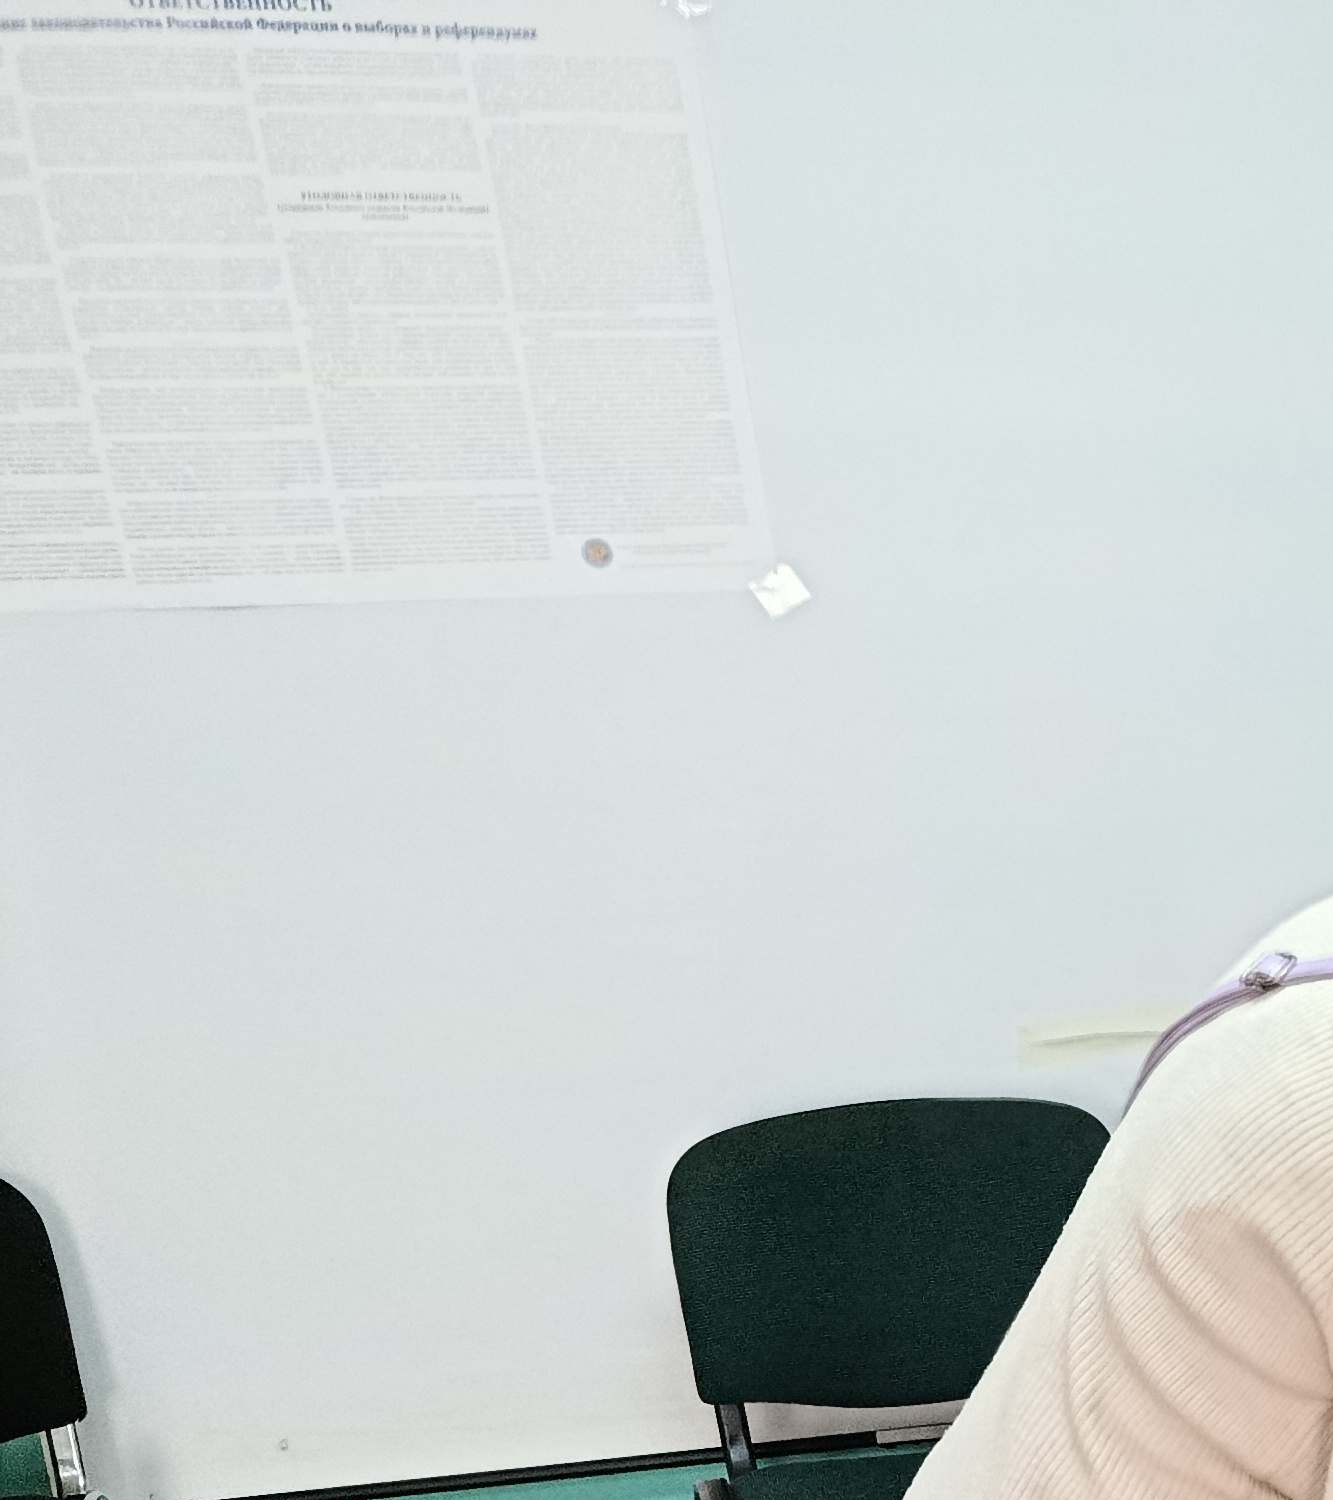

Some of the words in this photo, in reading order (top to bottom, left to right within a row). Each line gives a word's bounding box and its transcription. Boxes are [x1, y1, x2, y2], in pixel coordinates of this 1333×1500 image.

[166, 15, 253, 31] Российской
[256, 17, 340, 34] Федерации
[355, 19, 418, 38] выборах
[435, 22, 538, 44] референдумах
